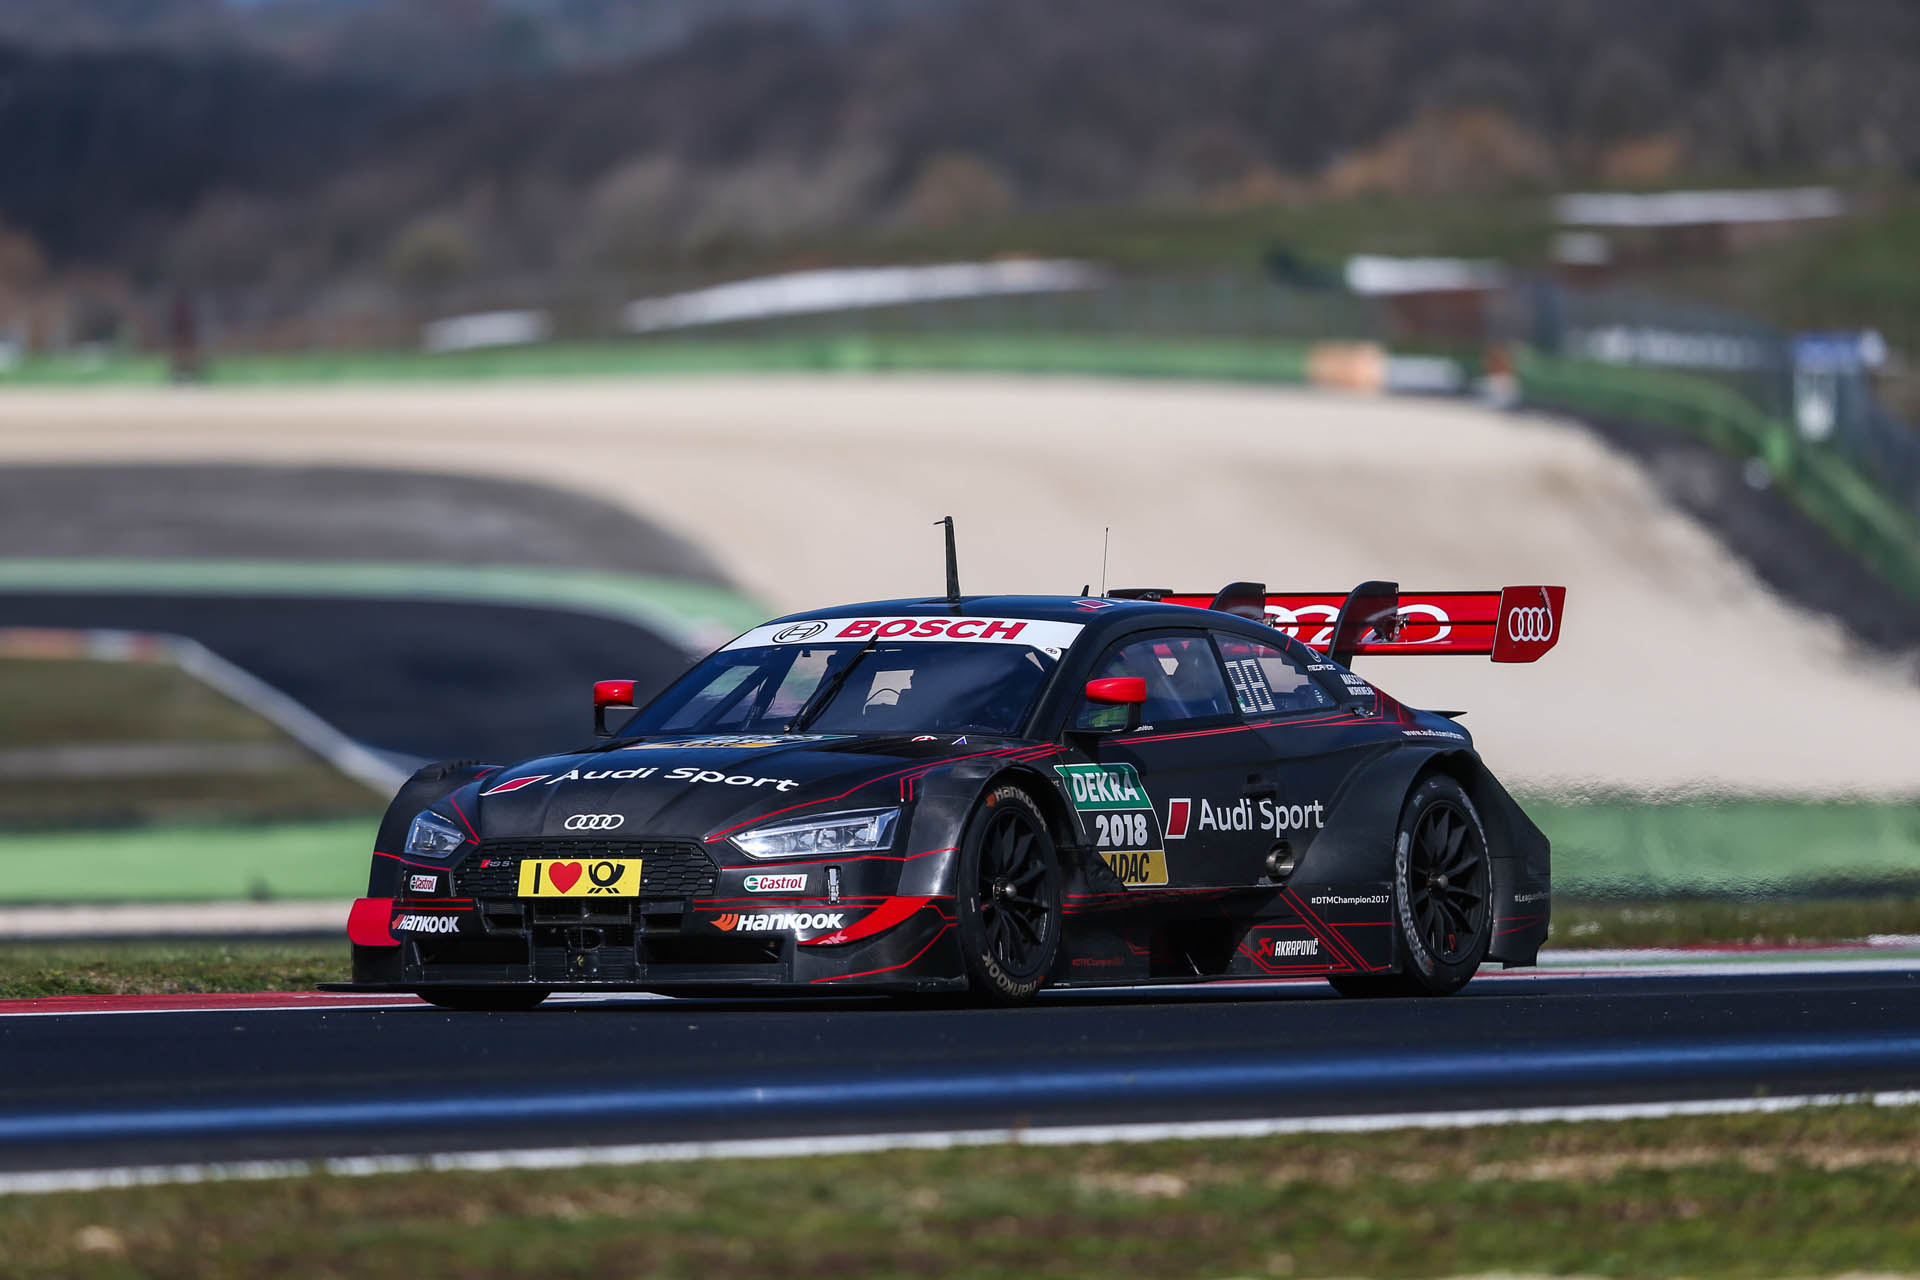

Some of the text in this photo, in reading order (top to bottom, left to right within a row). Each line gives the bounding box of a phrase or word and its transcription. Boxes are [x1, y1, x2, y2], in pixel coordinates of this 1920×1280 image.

[835, 620, 1027, 640] BOSCH
[545, 767, 799, 792] Audi Sport
[1071, 772, 1141, 803] DEKRA
[1096, 814, 1148, 847] 2018
[1199, 798, 1324, 838] Audi Sport
[1109, 853, 1150, 883] ADAC
[415, 877, 435, 890] Castrol
[760, 876, 803, 890] Castrol
[1311, 896, 1389, 905] #DTMChampion2017
